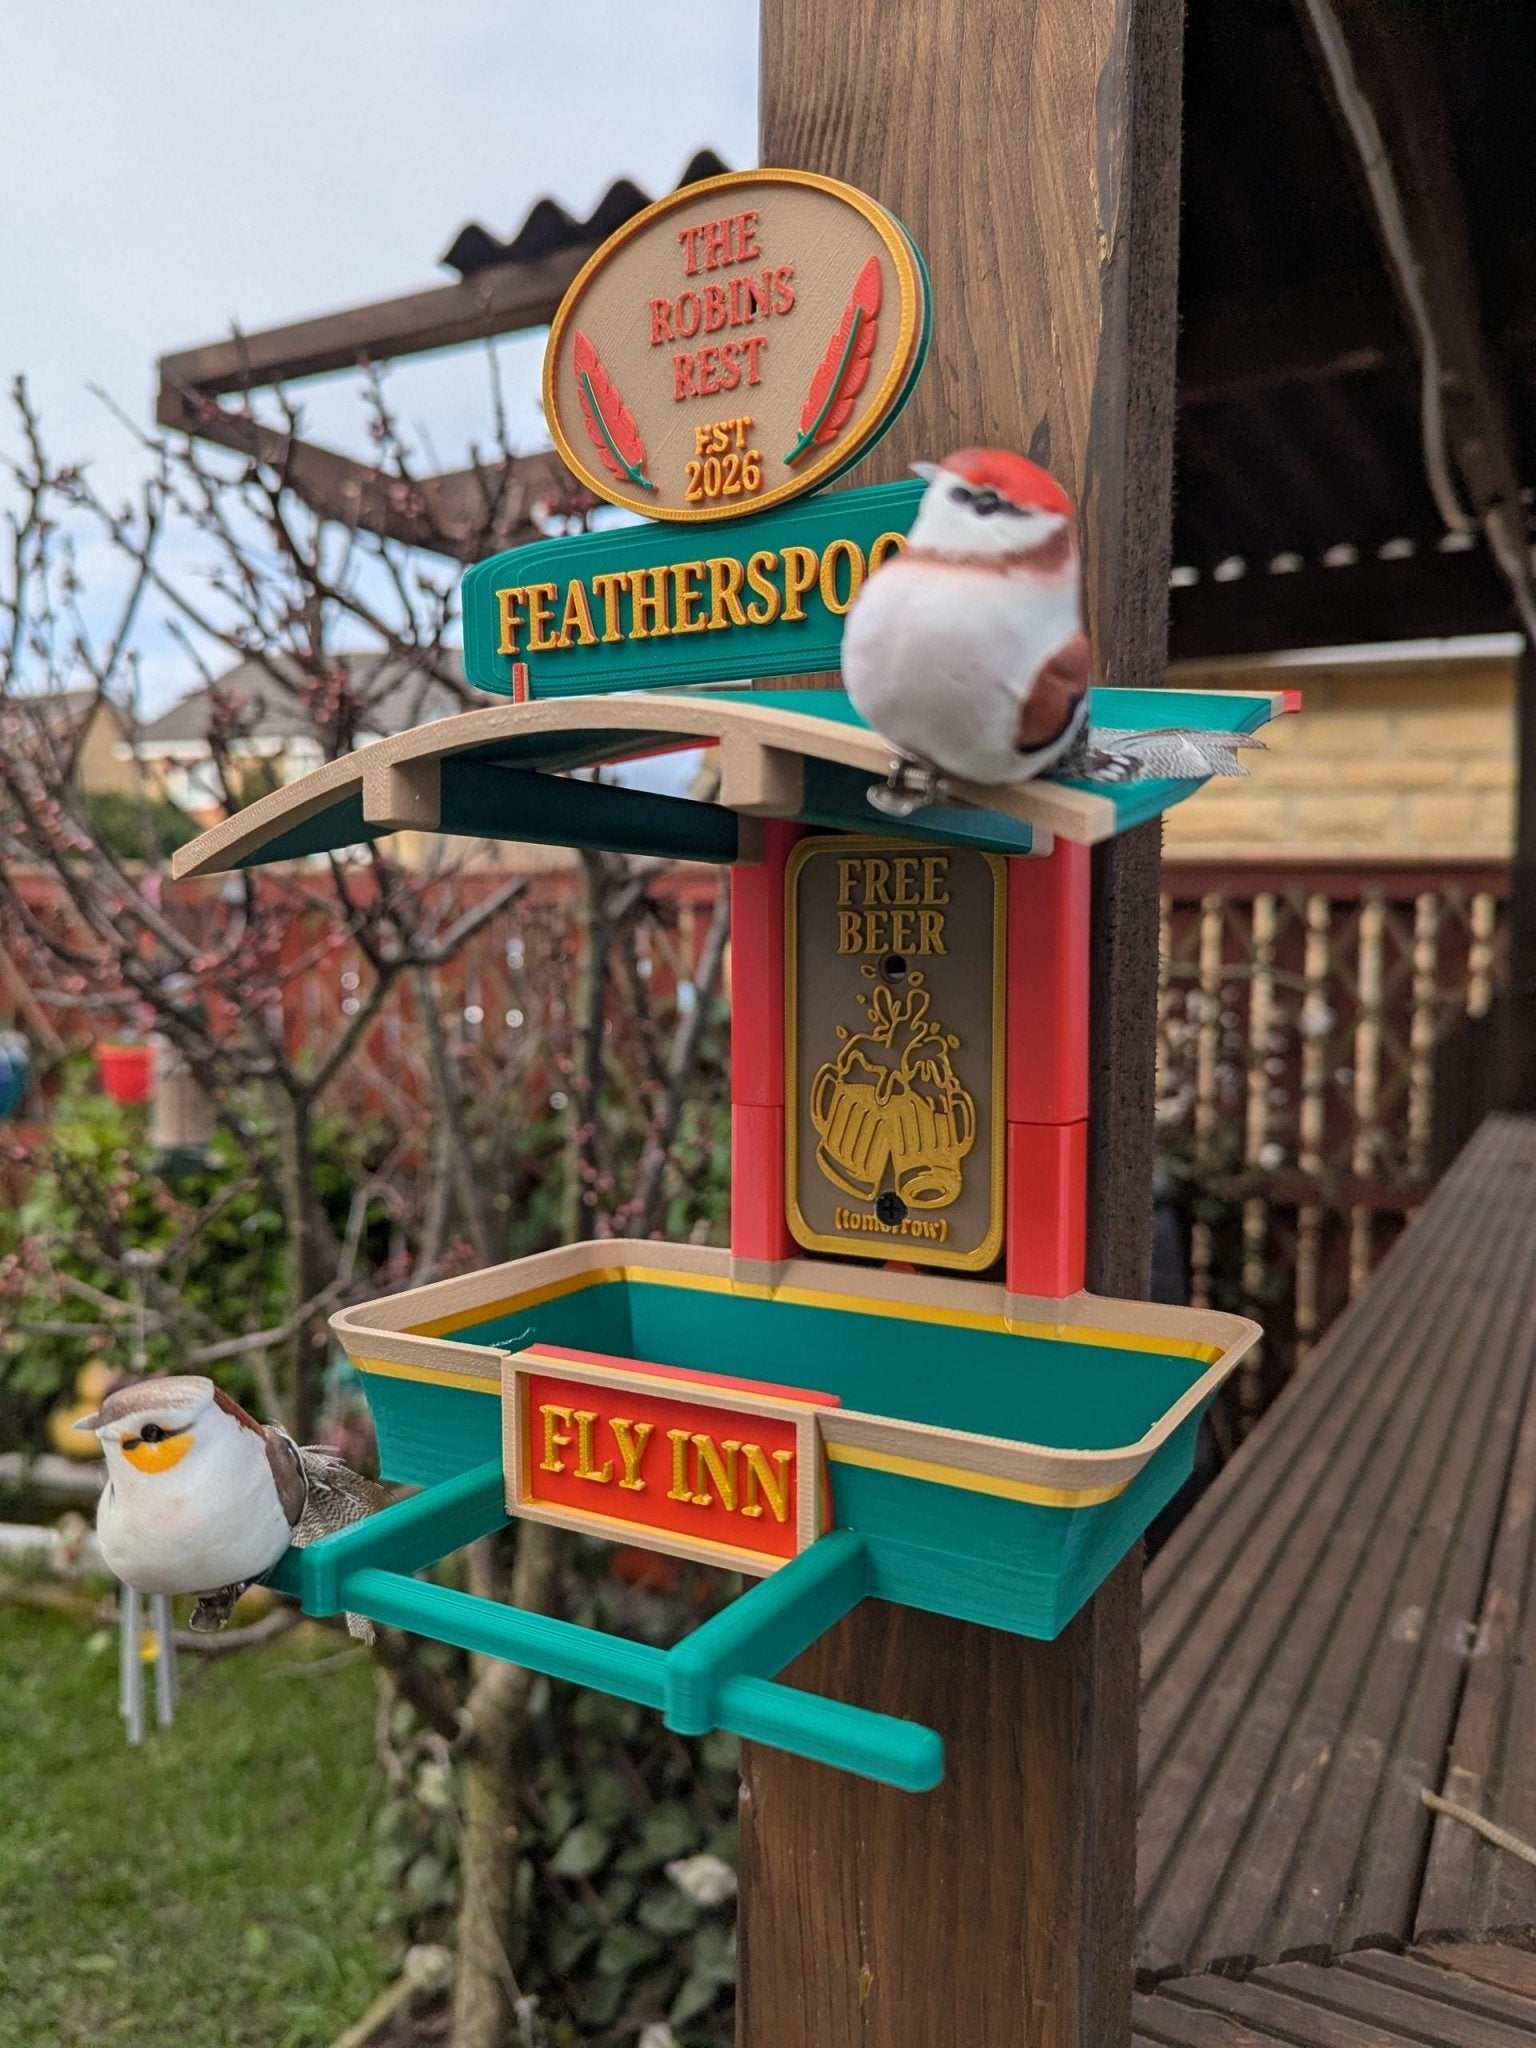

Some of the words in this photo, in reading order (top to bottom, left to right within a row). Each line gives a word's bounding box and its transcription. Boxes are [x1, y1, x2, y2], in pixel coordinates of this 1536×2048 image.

[678, 210, 761, 275] THE
[648, 265, 795, 346] ROBINS
[672, 336, 767, 400] REST
[694, 417, 753, 456] EST
[684, 449, 763, 502] 2026
[836, 856, 950, 906] FREE
[837, 910, 947, 955] BEER
[539, 1403, 655, 1491] FLY
[666, 1428, 794, 1523] INN
